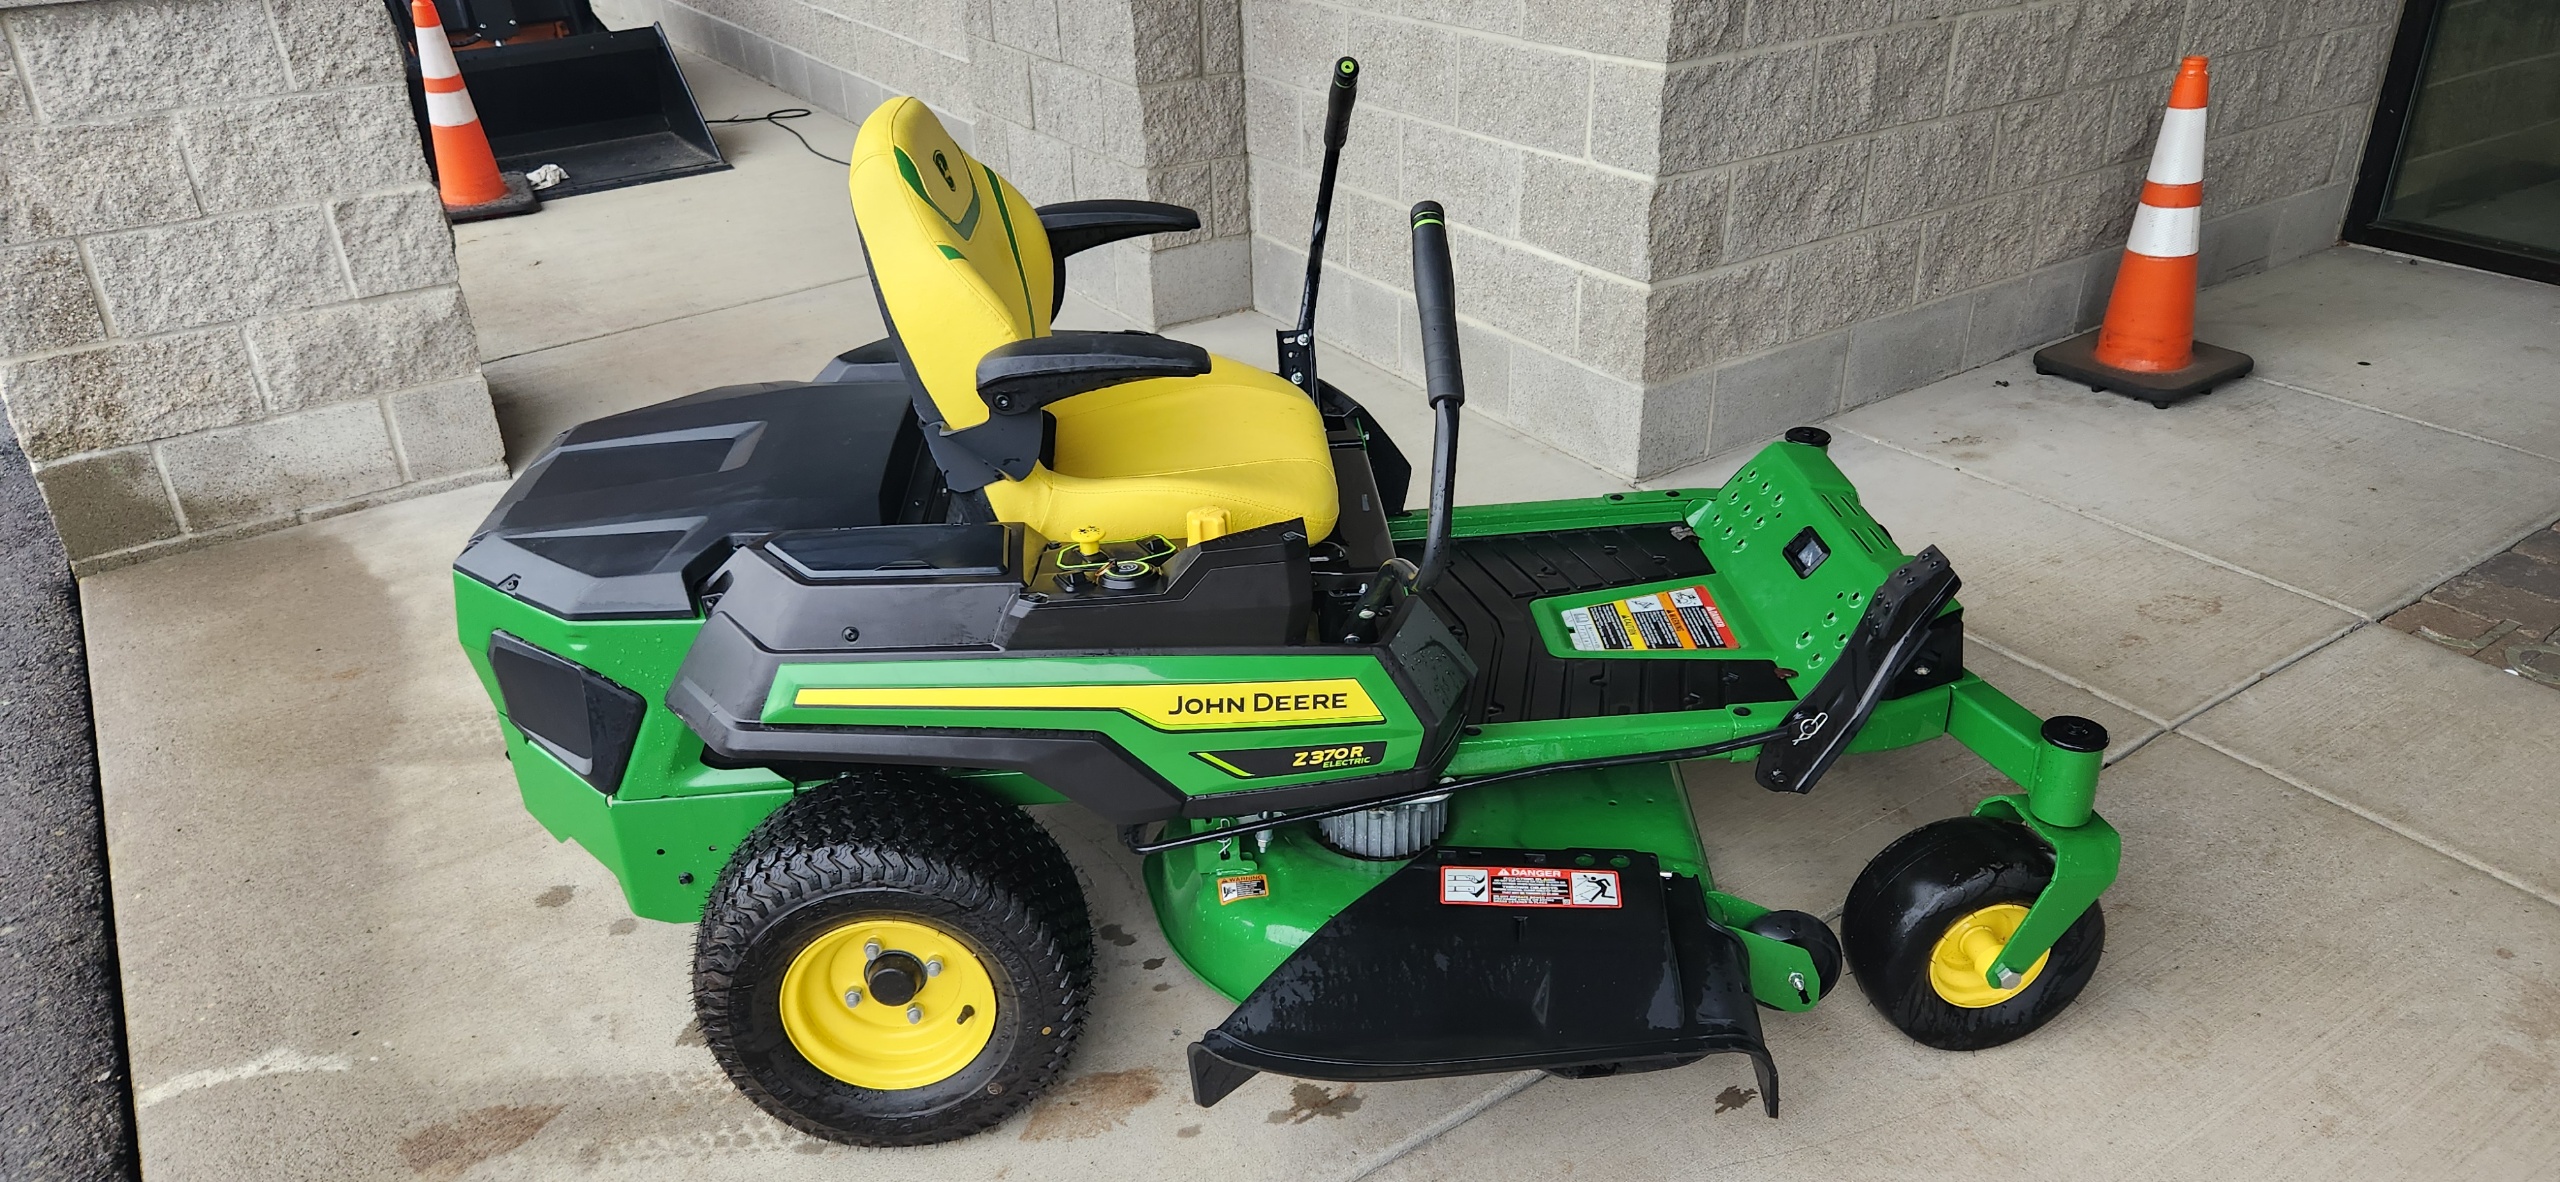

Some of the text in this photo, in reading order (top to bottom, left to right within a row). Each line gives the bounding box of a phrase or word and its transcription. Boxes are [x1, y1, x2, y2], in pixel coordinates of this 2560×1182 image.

[1168, 692, 1348, 715] JOHN DEERE
[1322, 756, 1371, 768] ELECTRIC
[1511, 868, 1561, 877] DANGER
